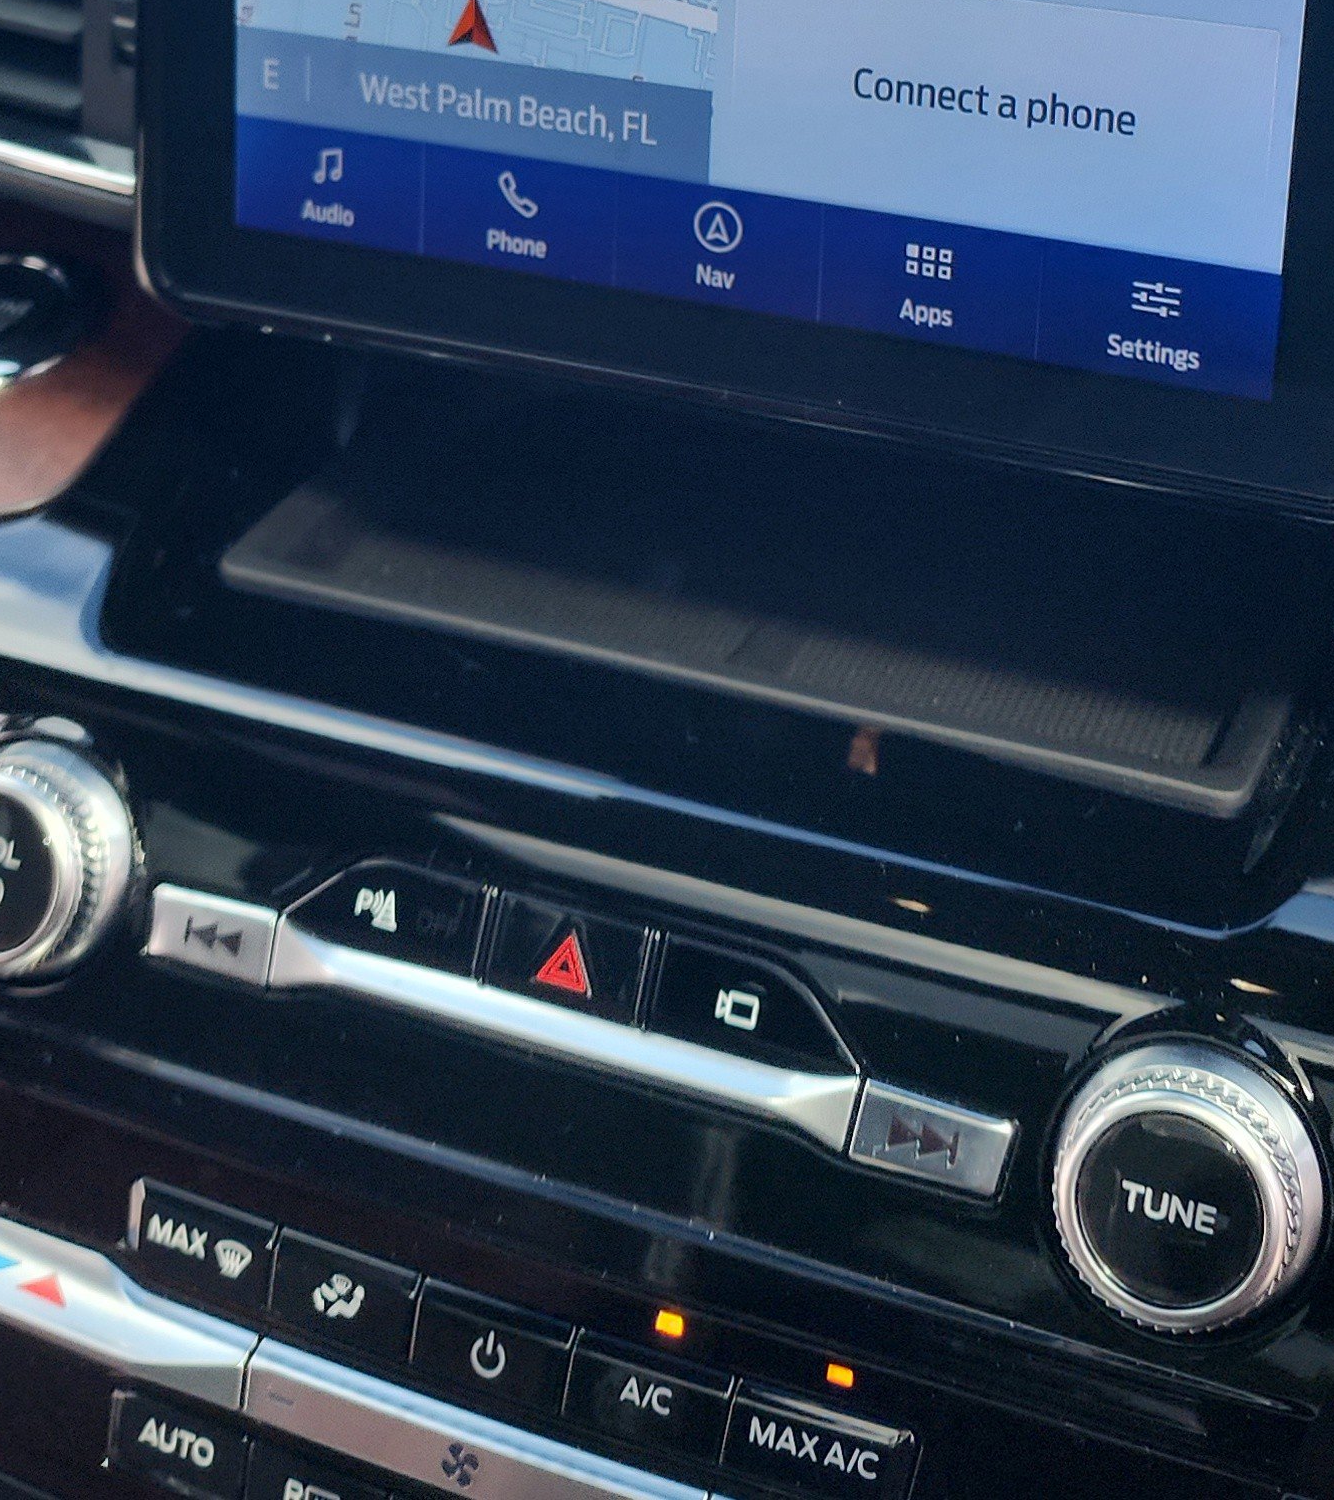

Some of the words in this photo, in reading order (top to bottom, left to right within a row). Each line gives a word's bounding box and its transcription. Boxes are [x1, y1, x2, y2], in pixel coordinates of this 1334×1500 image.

[264, 57, 280, 90] E
[359, 72, 433, 112] West
[436, 82, 512, 125] Palm
[518, 95, 615, 143] Beach,
[622, 110, 658, 147] FL
[853, 67, 990, 116] Connect
[996, 93, 1017, 120] a
[1026, 92, 1137, 137] phone
[300, 198, 355, 228] Audio
[486, 228, 547, 259] Phone
[695, 263, 736, 290] Nav
[899, 297, 953, 329] Apps
[1107, 333, 1201, 372] Settings
[1121, 1178, 1218, 1236] TUNE
[147, 1213, 209, 1260] MAX
[618, 1375, 673, 1416] A/C
[137, 1416, 216, 1469] AUTO
[748, 1415, 825, 1464] MAX
[823, 1440, 880, 1481] A/C
